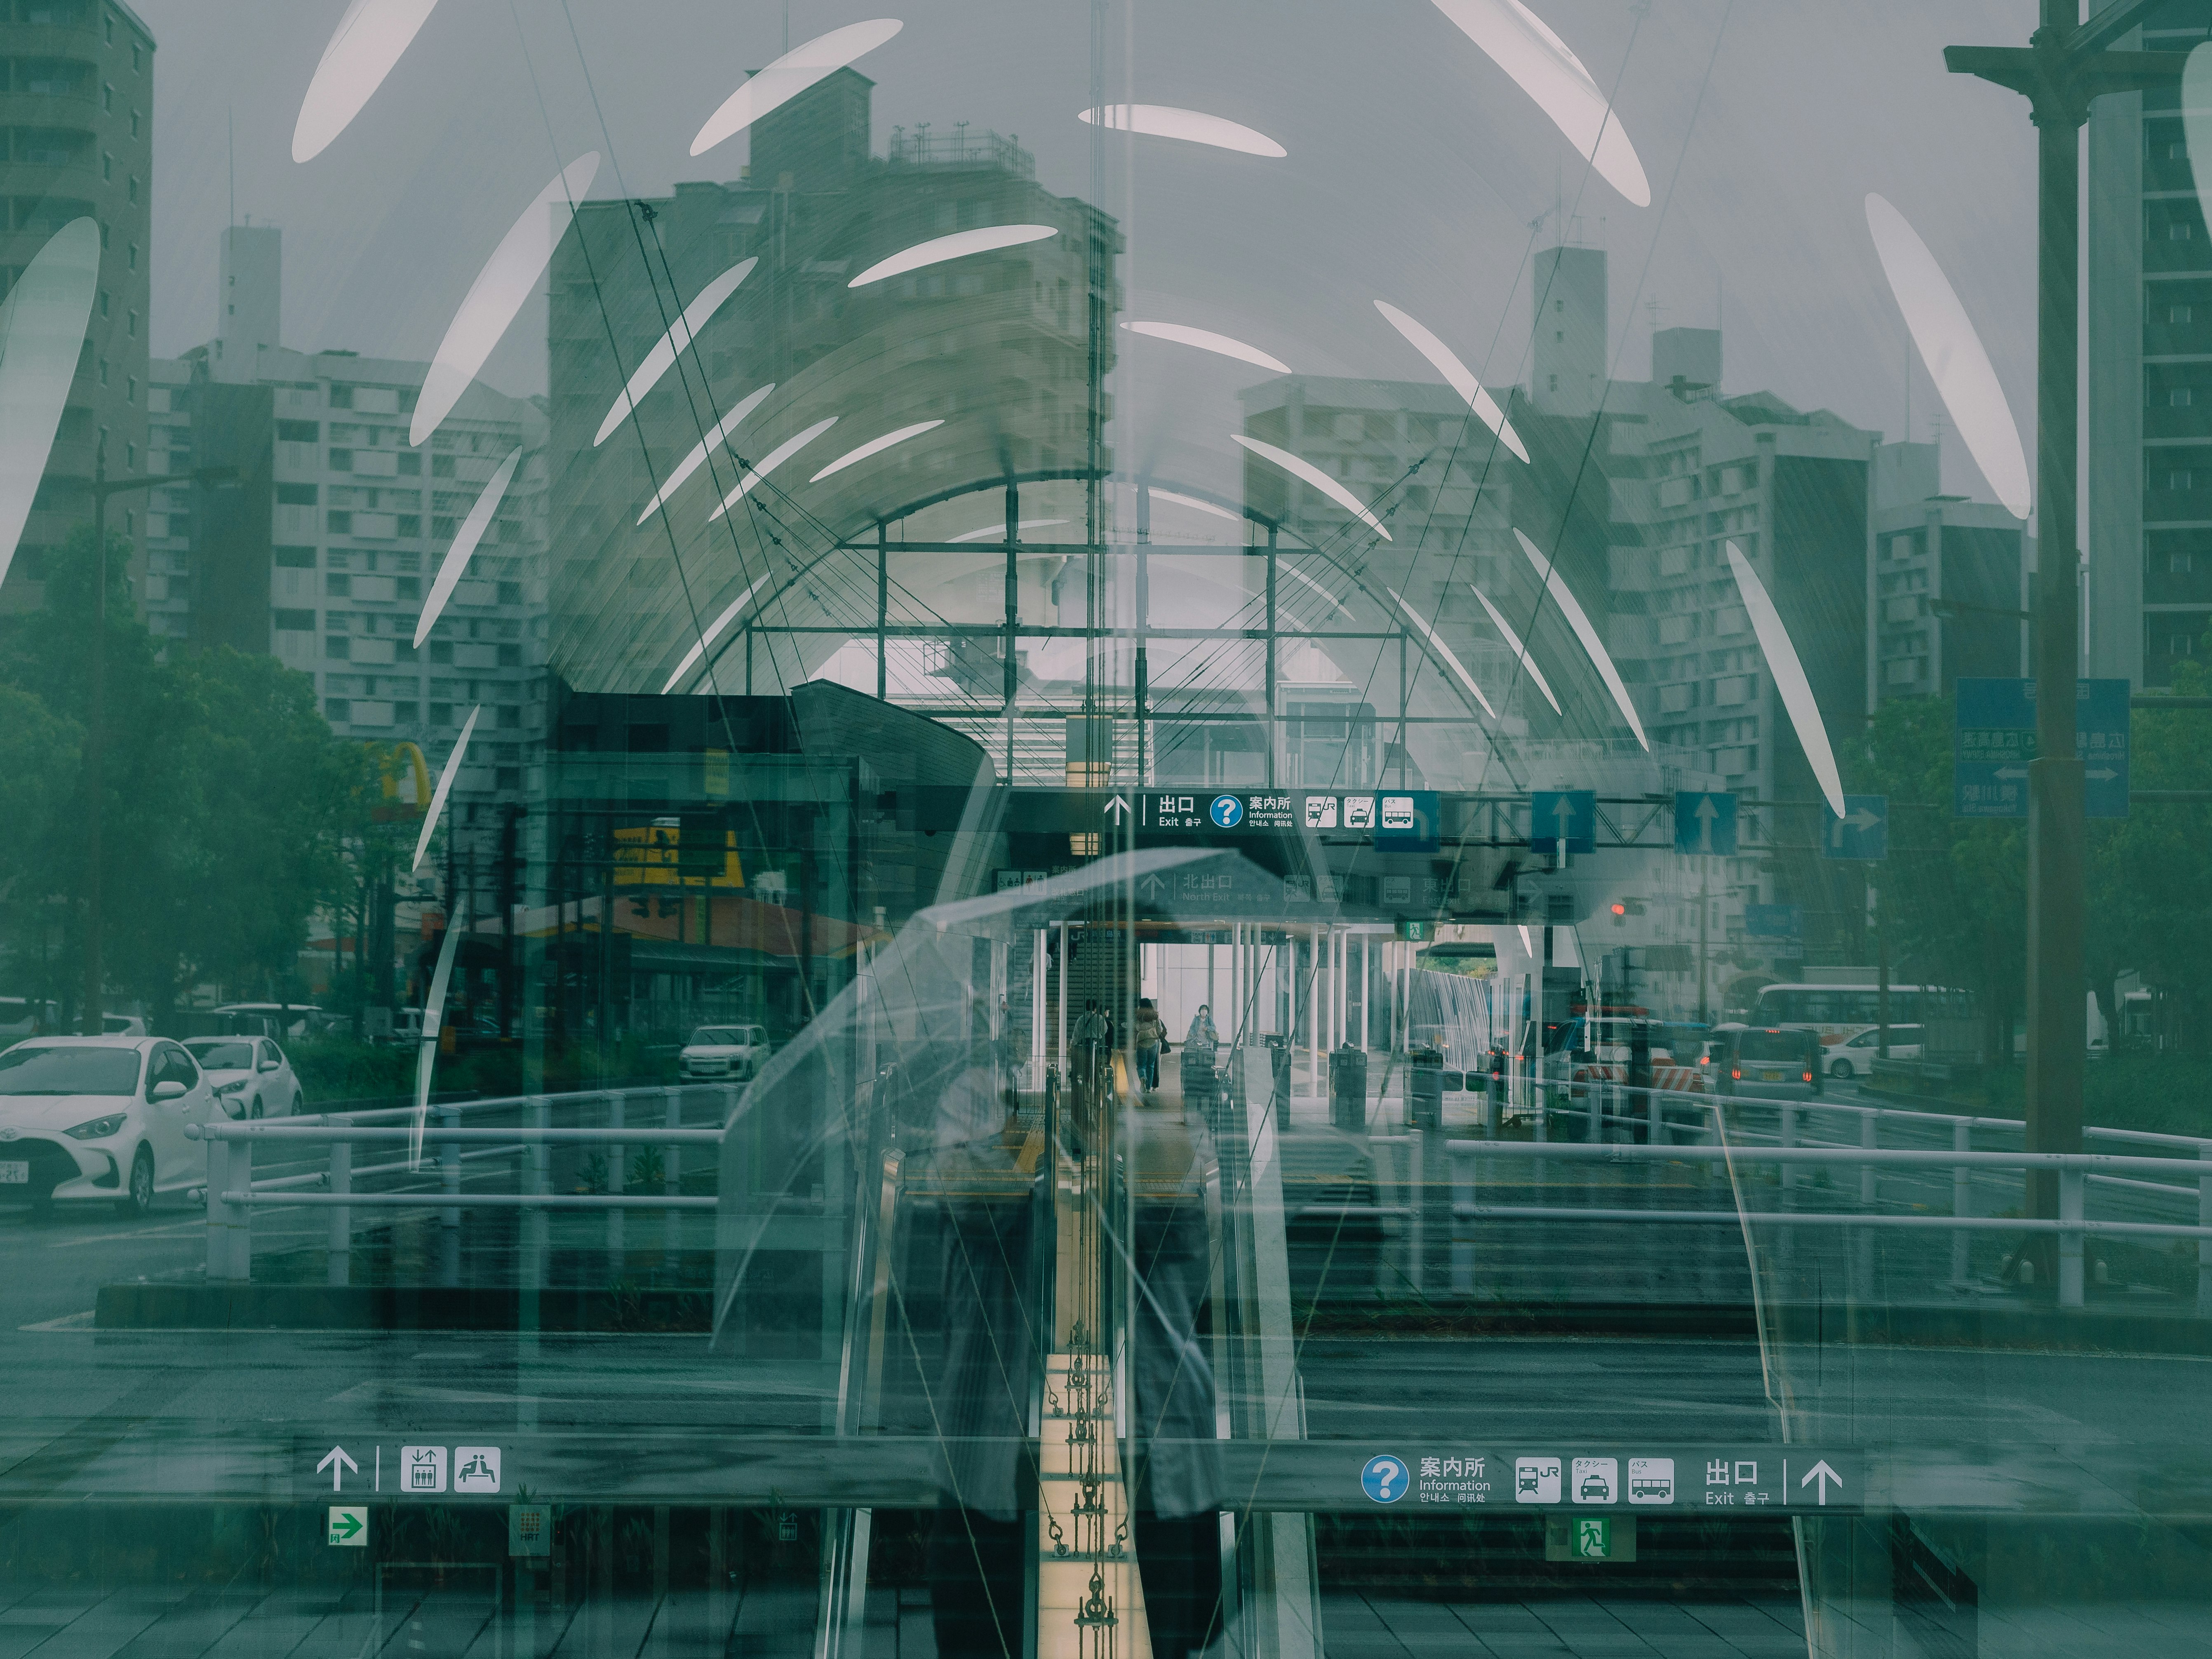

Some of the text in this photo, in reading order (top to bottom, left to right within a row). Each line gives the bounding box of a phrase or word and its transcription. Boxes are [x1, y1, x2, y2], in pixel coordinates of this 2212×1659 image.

[1159, 795, 1194, 813] 出口
[1249, 796, 1291, 810] 案内所
[1159, 817, 1201, 827] Exit 출구
[1183, 873, 1232, 889] 北出口
[1423, 877, 1471, 892] 東出口
[1182, 892, 1210, 900] North
[1423, 895, 1441, 904] East
[1420, 1457, 1485, 1478] 案内所
[1540, 1466, 1559, 1478] JR
[1706, 1459, 1757, 1485] 出口
[1420, 1479, 1490, 1491] Information
[1420, 1492, 1486, 1503] 안내소 问讯处
[1706, 1492, 1770, 1505] Exit 출구
